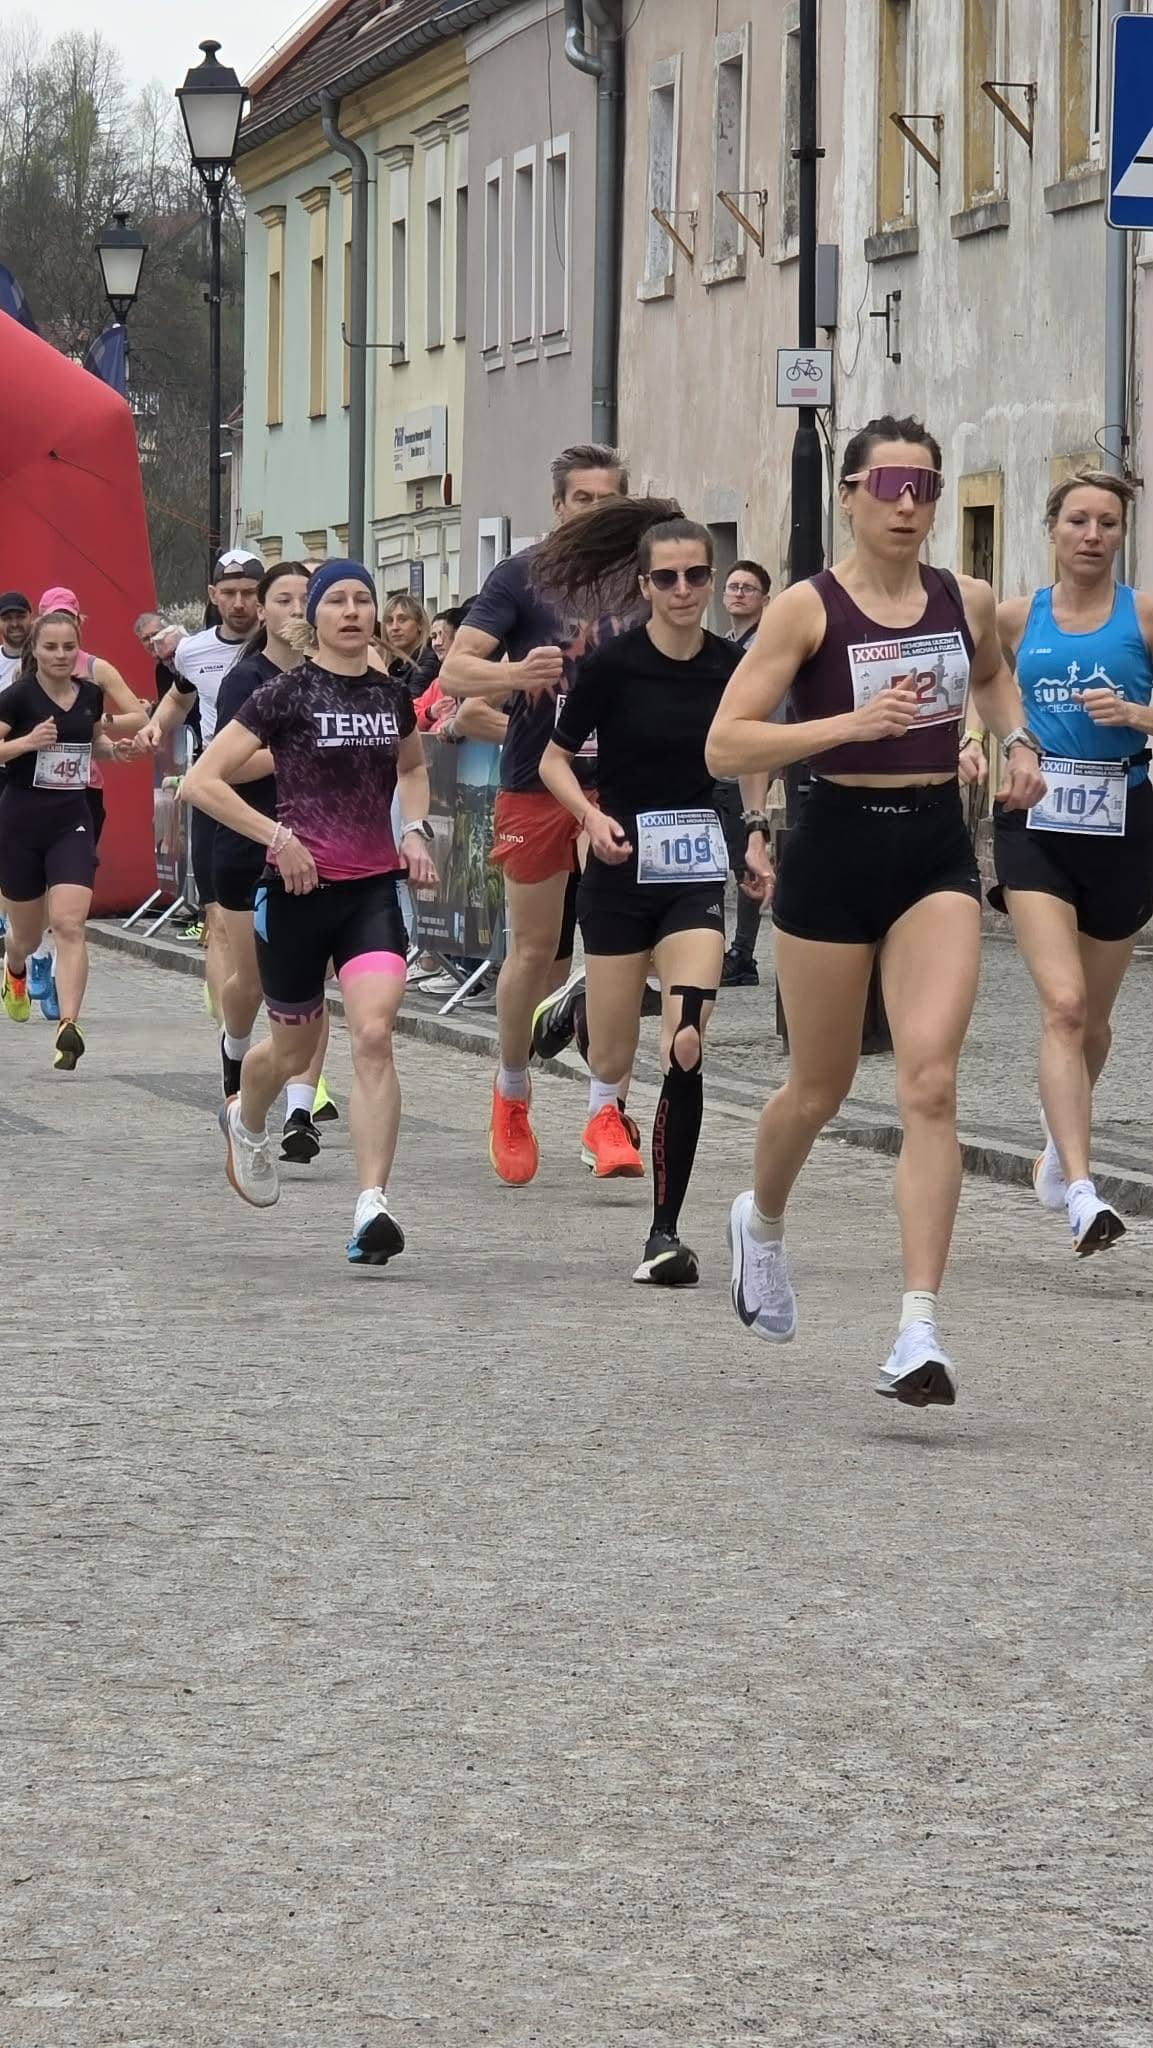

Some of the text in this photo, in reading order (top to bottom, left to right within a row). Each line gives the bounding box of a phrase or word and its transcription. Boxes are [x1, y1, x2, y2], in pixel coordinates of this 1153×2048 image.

[854, 645, 898, 663] XXXIII
[53, 760, 78, 778] 49
[1053, 786, 1108, 816] 107
[642, 814, 674, 827] XXXIII
[660, 838, 711, 865] 109
